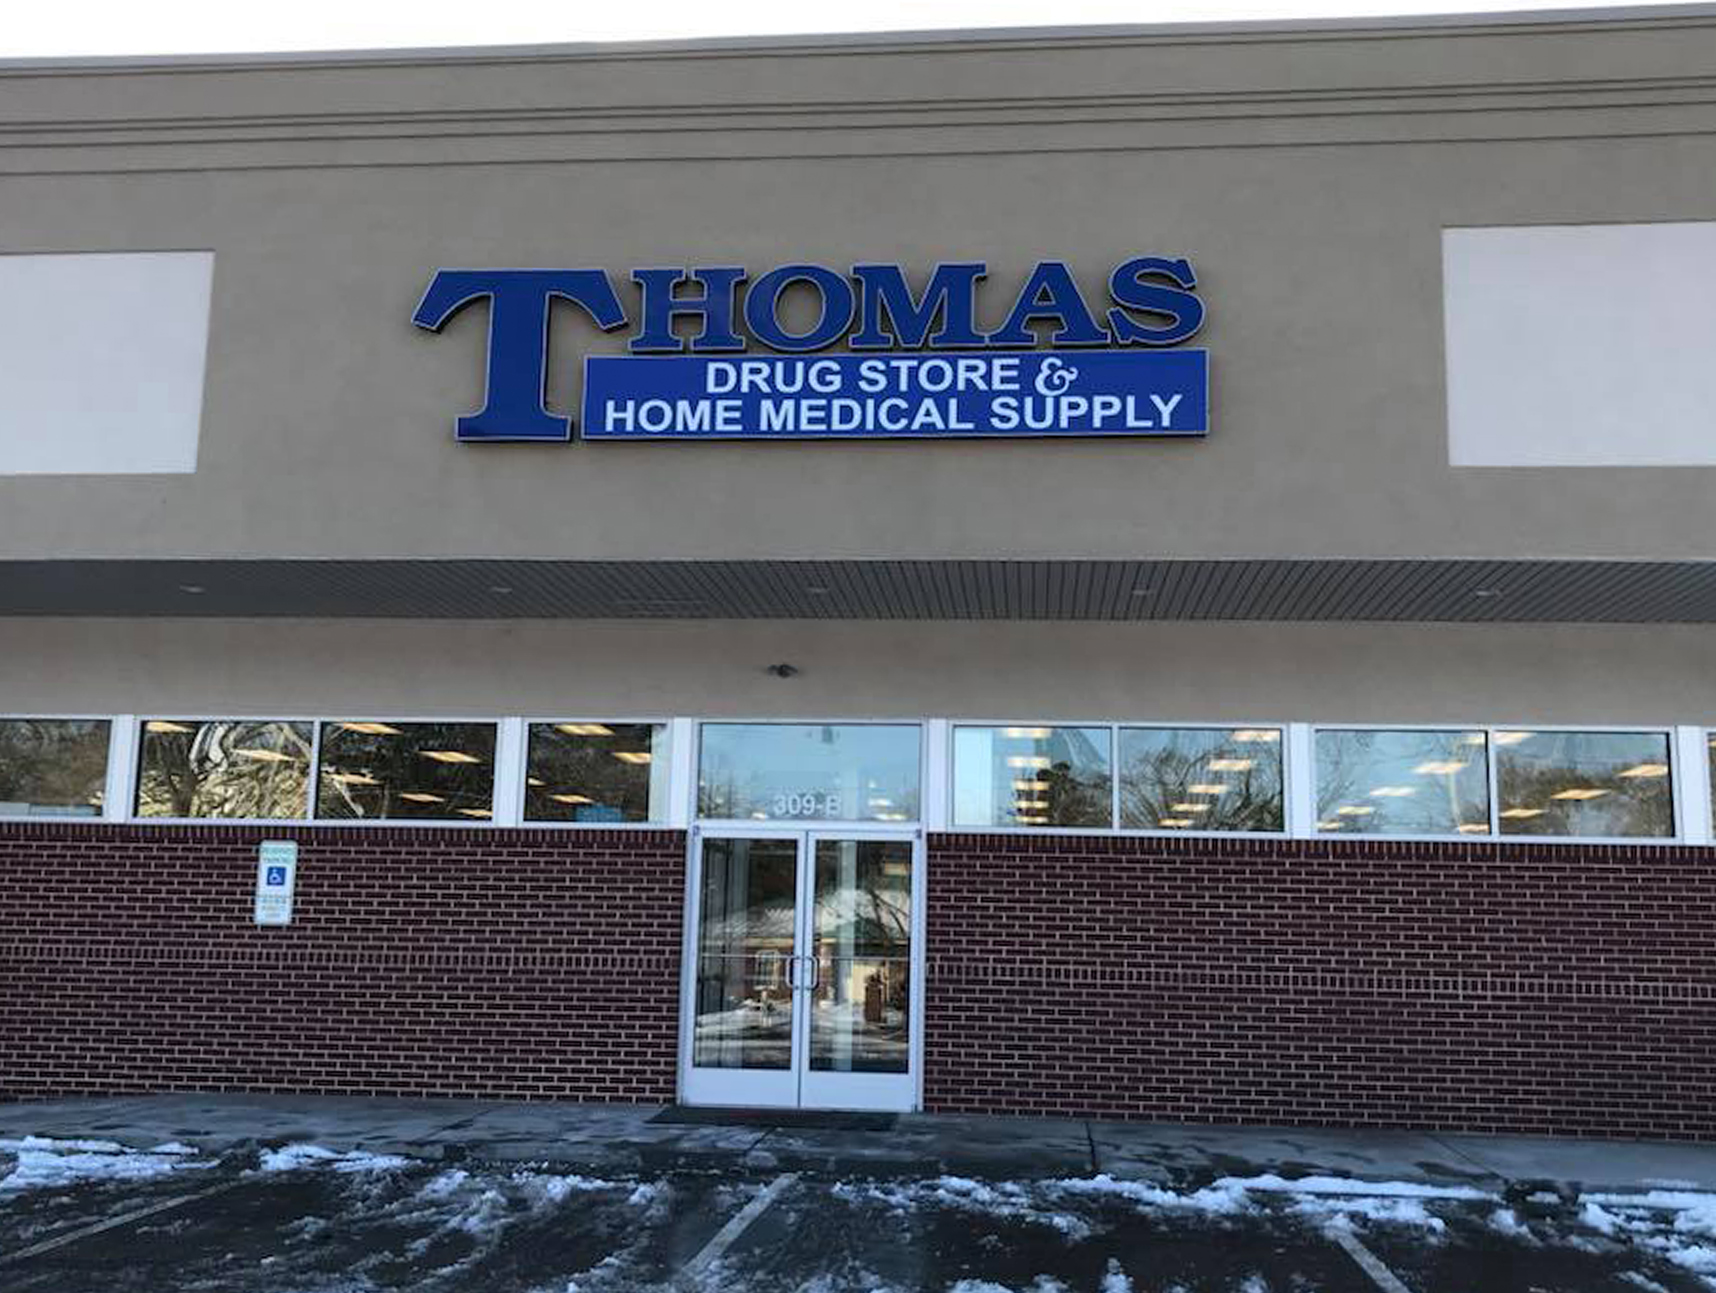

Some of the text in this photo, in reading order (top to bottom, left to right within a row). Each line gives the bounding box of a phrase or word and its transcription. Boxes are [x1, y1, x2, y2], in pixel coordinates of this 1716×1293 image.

[411, 257, 1206, 441] THOMAS
[705, 356, 1078, 396] DRUG STORE &
[604, 393, 1183, 431] HOME MEDICAL SUPPLY
[774, 794, 841, 815] 309-B
